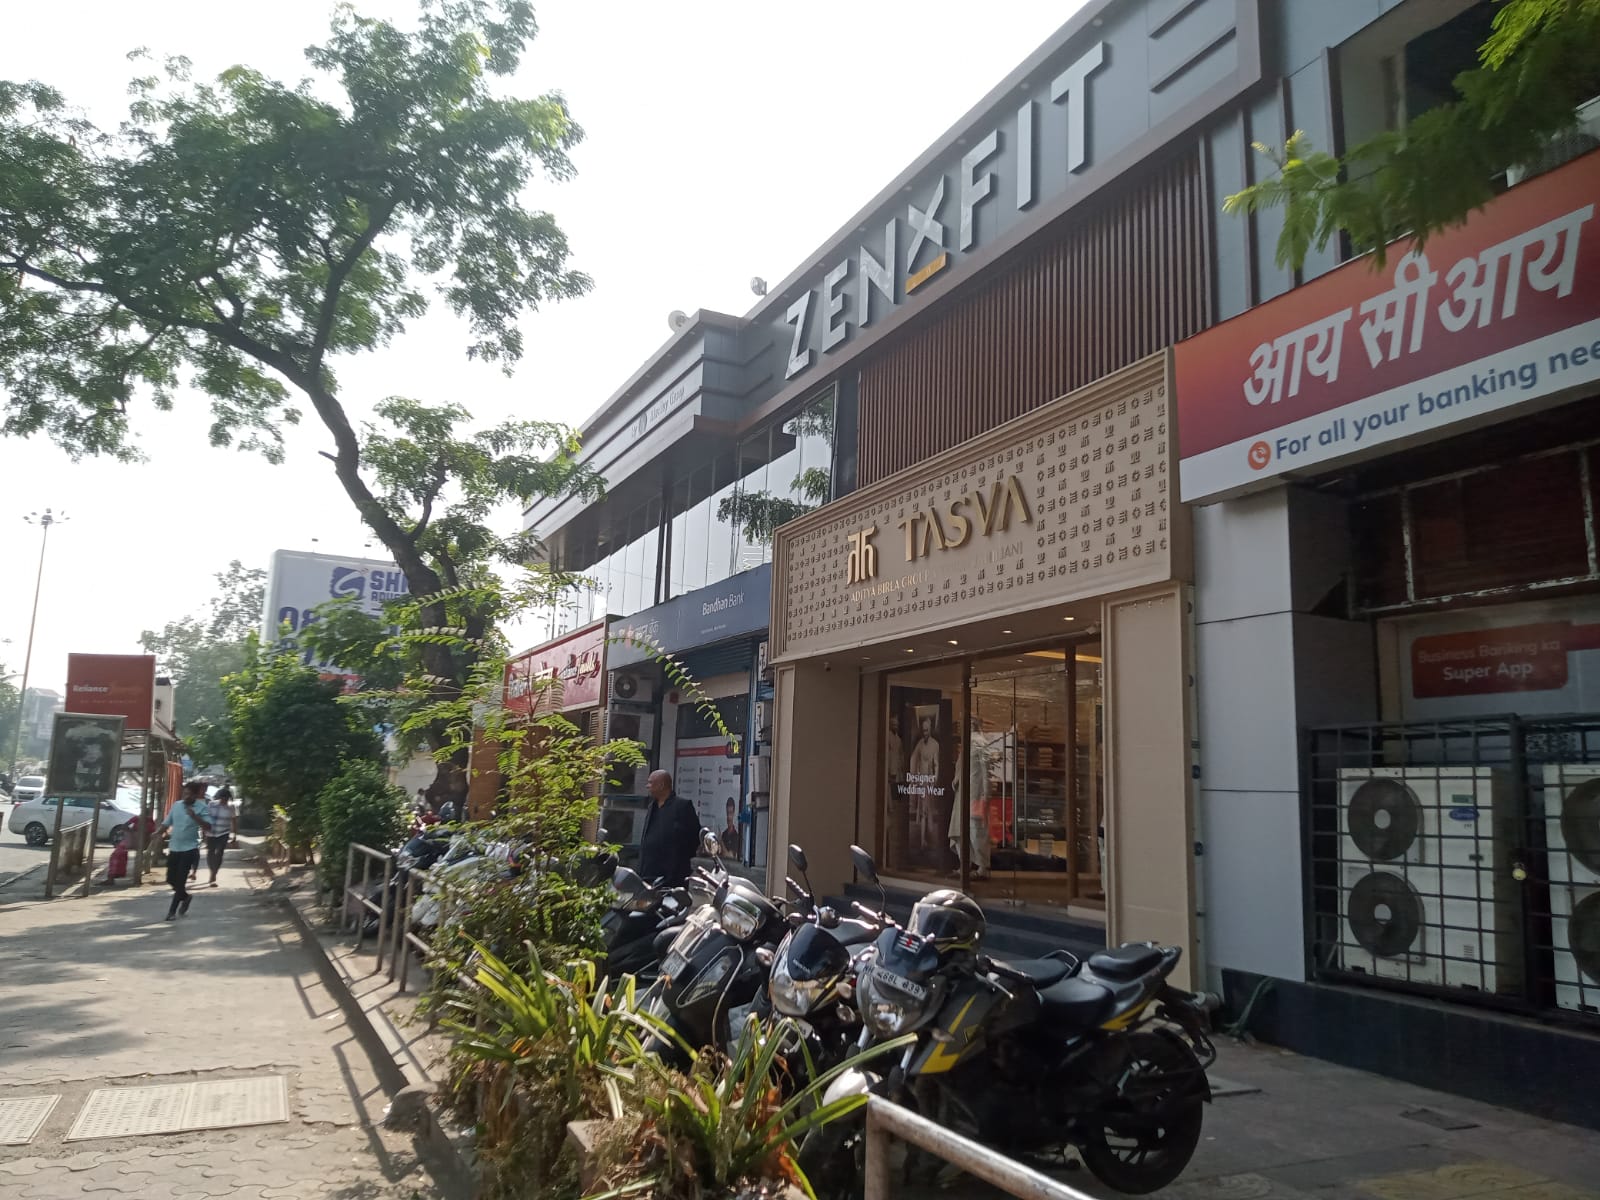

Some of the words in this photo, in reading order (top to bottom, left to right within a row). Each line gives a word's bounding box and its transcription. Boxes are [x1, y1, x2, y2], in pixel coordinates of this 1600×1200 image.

[785, 40, 1104, 380] ZENXFIT
[1275, 435, 1311, 460] For
[1318, 419, 1346, 447] all
[1353, 403, 1410, 440] your
[1417, 363, 1538, 416] banking
[898, 474, 1032, 562] TASVA
[850, 584, 877, 602] ADITYA
[877, 579, 901, 595] BIRLA
[901, 569, 930, 587] GROUP
[702, 597, 729, 616] Bandhan
[729, 592, 745, 608] Bank
[1479, 643, 1537, 657] Banking
[1442, 666, 1490, 682] Super
[1496, 662, 1534, 678] App
[72, 684, 109, 693] Reliance
[906, 771, 936, 785] Designer
[897, 785, 926, 797] Wedding
[926, 785, 945, 797] Wear
